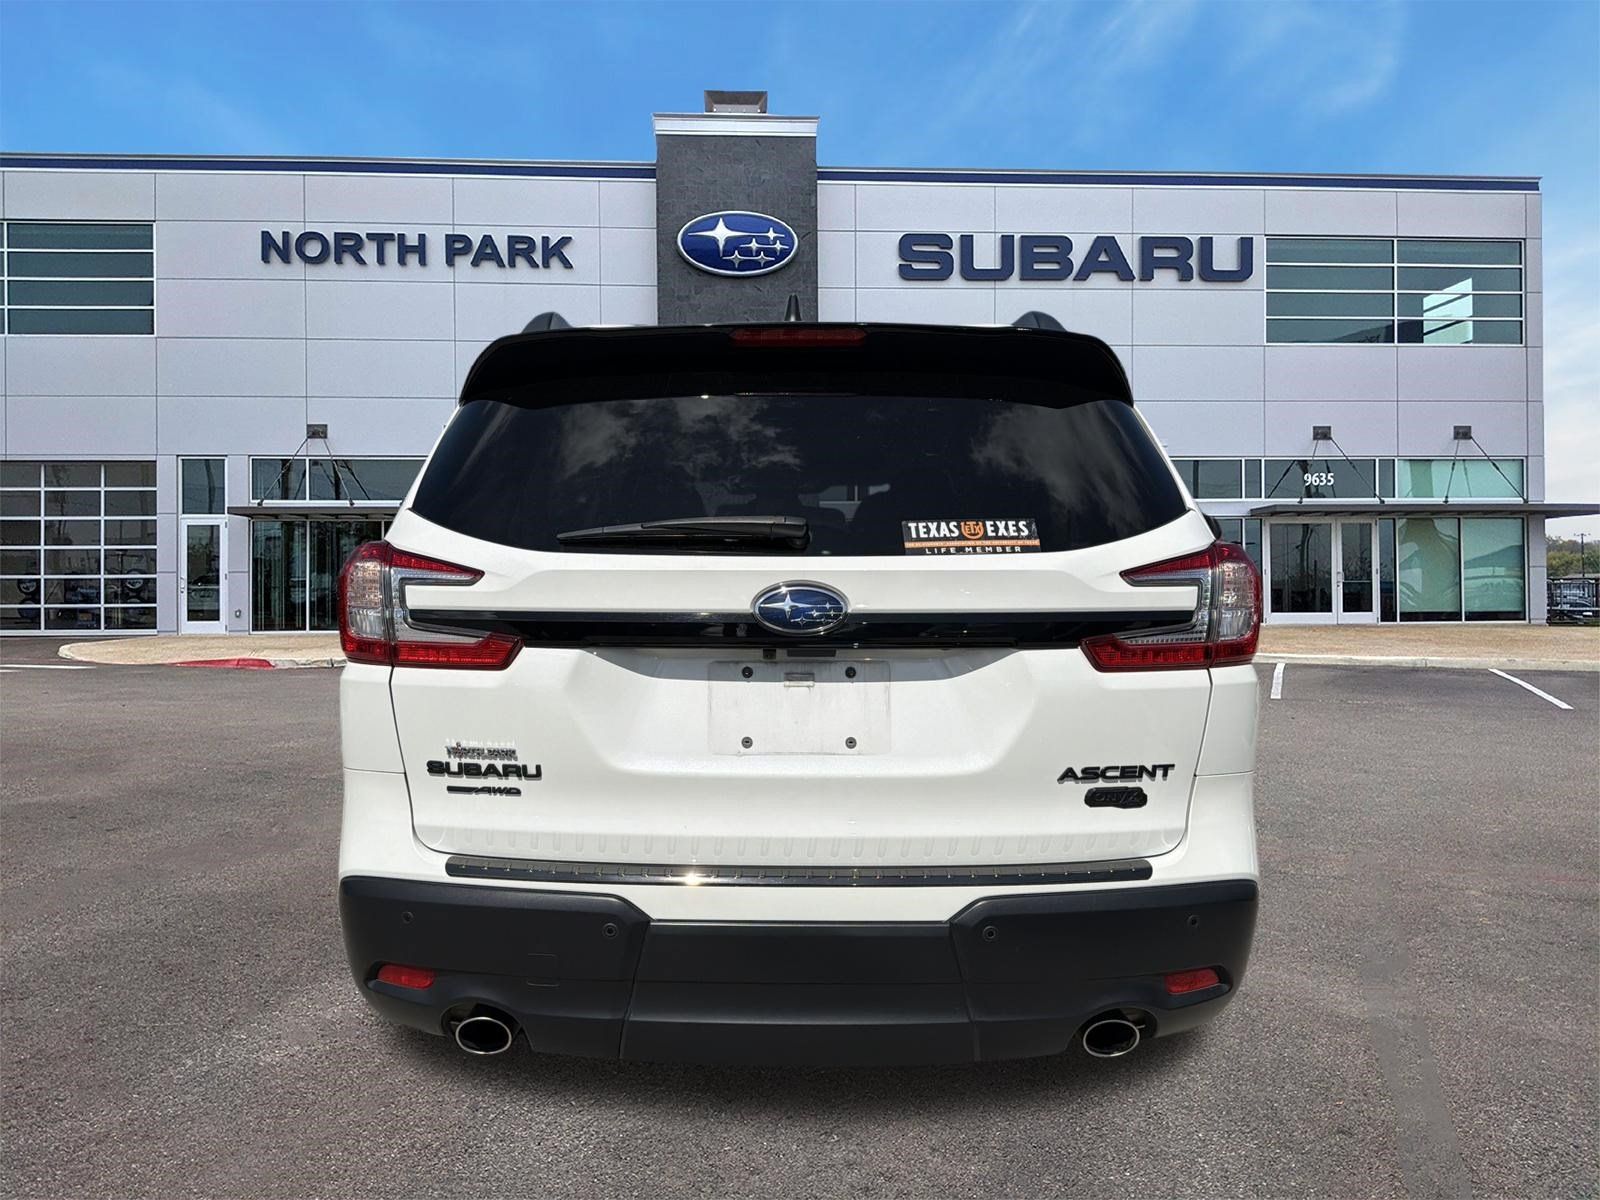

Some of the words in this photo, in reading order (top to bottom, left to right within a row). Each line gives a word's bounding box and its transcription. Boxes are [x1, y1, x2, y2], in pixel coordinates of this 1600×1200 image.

[260, 230, 427, 266] NORTH
[444, 233, 574, 269] PARK
[898, 232, 1254, 282] SUBARU
[1303, 472, 1335, 486] 9635
[908, 521, 960, 538] TEXAS
[986, 520, 1029, 537] EXES
[925, 546, 957, 554] LIFE
[426, 760, 542, 780] SUBARU
[1057, 764, 1175, 784] ASCENT
[474, 786, 521, 796] AWD
